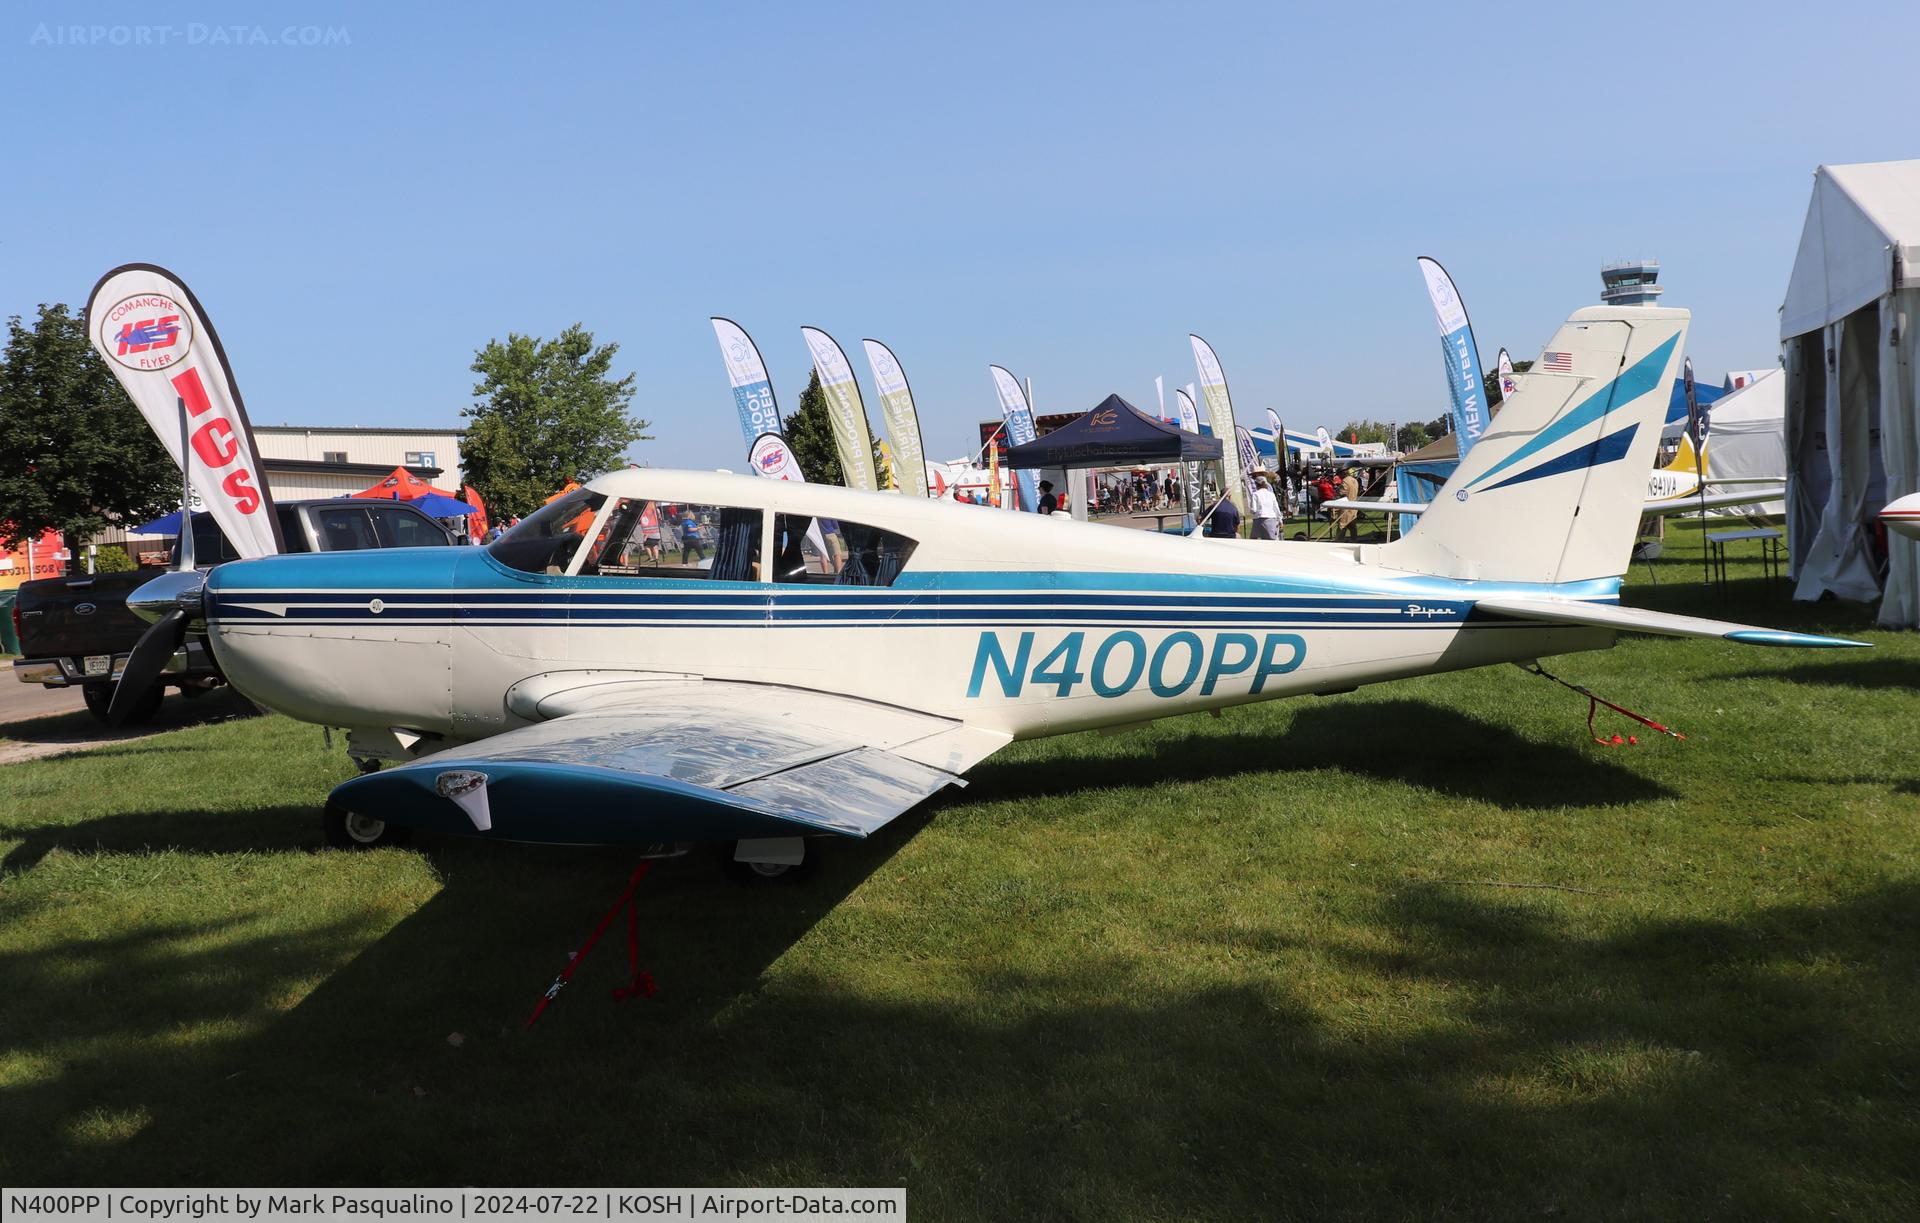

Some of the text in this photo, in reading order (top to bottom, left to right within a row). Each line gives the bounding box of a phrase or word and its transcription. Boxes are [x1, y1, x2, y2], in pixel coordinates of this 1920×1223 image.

[111, 297, 174, 322] COMANCHE
[140, 354, 173, 368] FLYER
[170, 366, 260, 515] ICS
[1403, 604, 1456, 619] Piper
[966, 630, 1307, 699] N400PP
